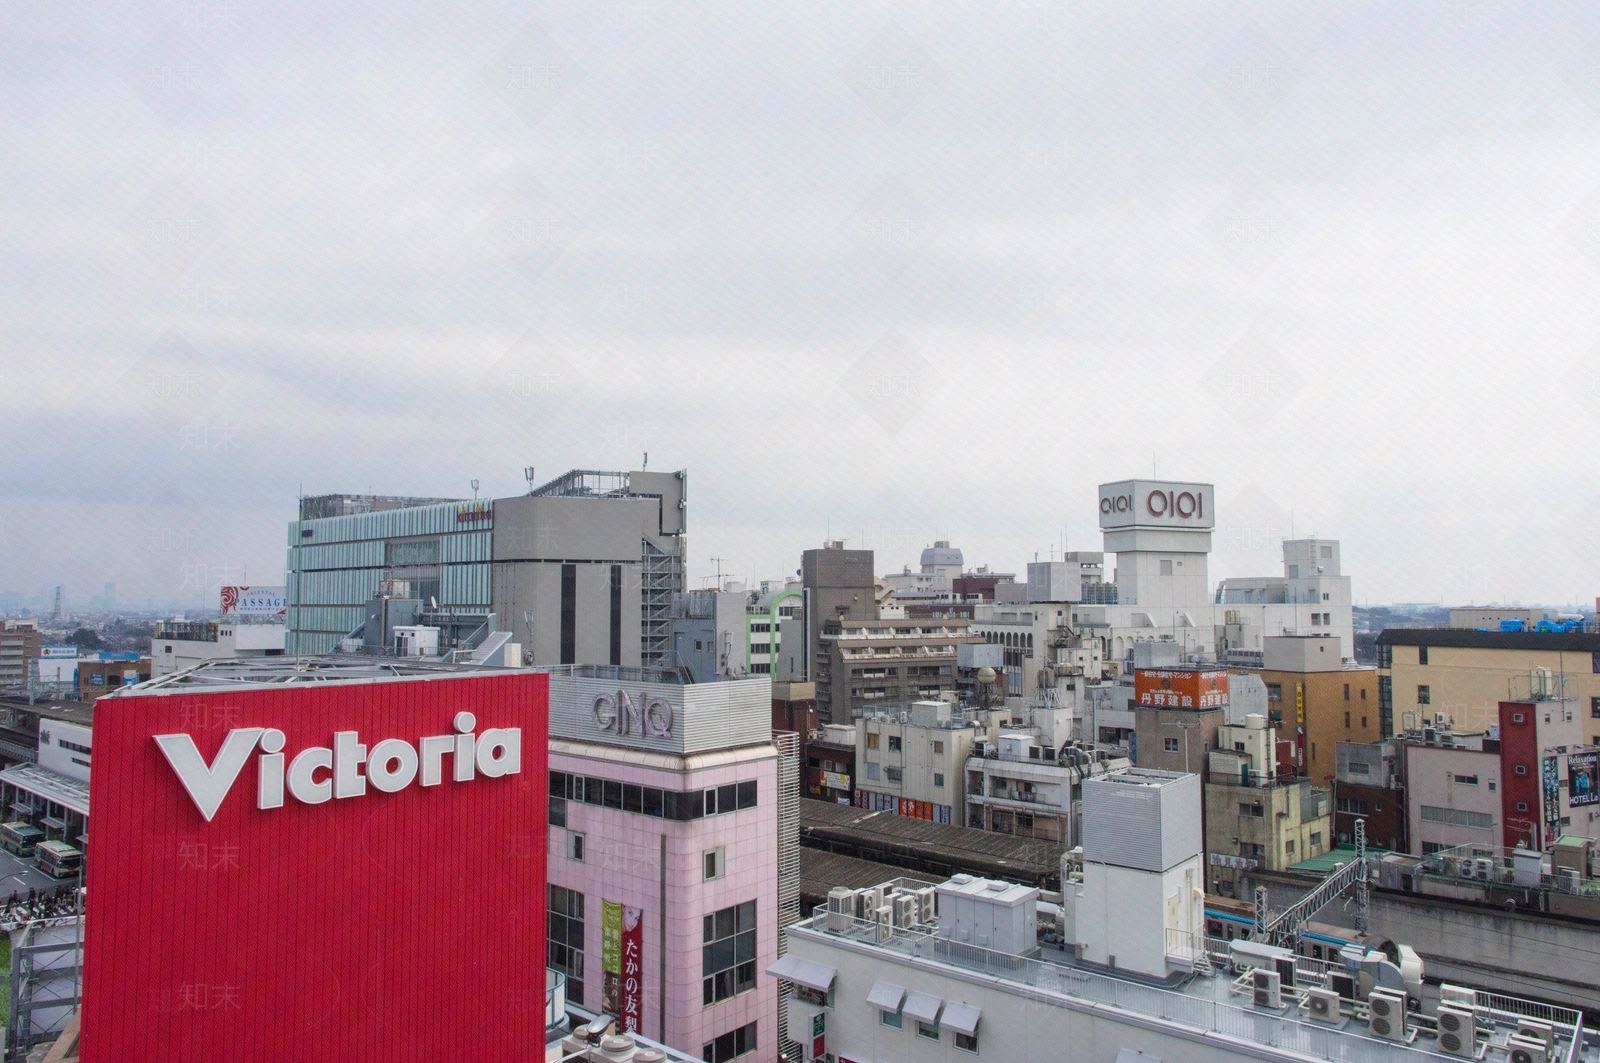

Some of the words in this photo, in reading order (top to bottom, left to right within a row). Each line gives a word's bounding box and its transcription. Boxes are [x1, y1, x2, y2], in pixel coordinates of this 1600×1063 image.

[590, 689, 673, 738] CINQ
[1141, 693, 1192, 707] 丹野建設
[153, 712, 522, 823] Victoria
[1569, 795, 1590, 804] HOTEL
